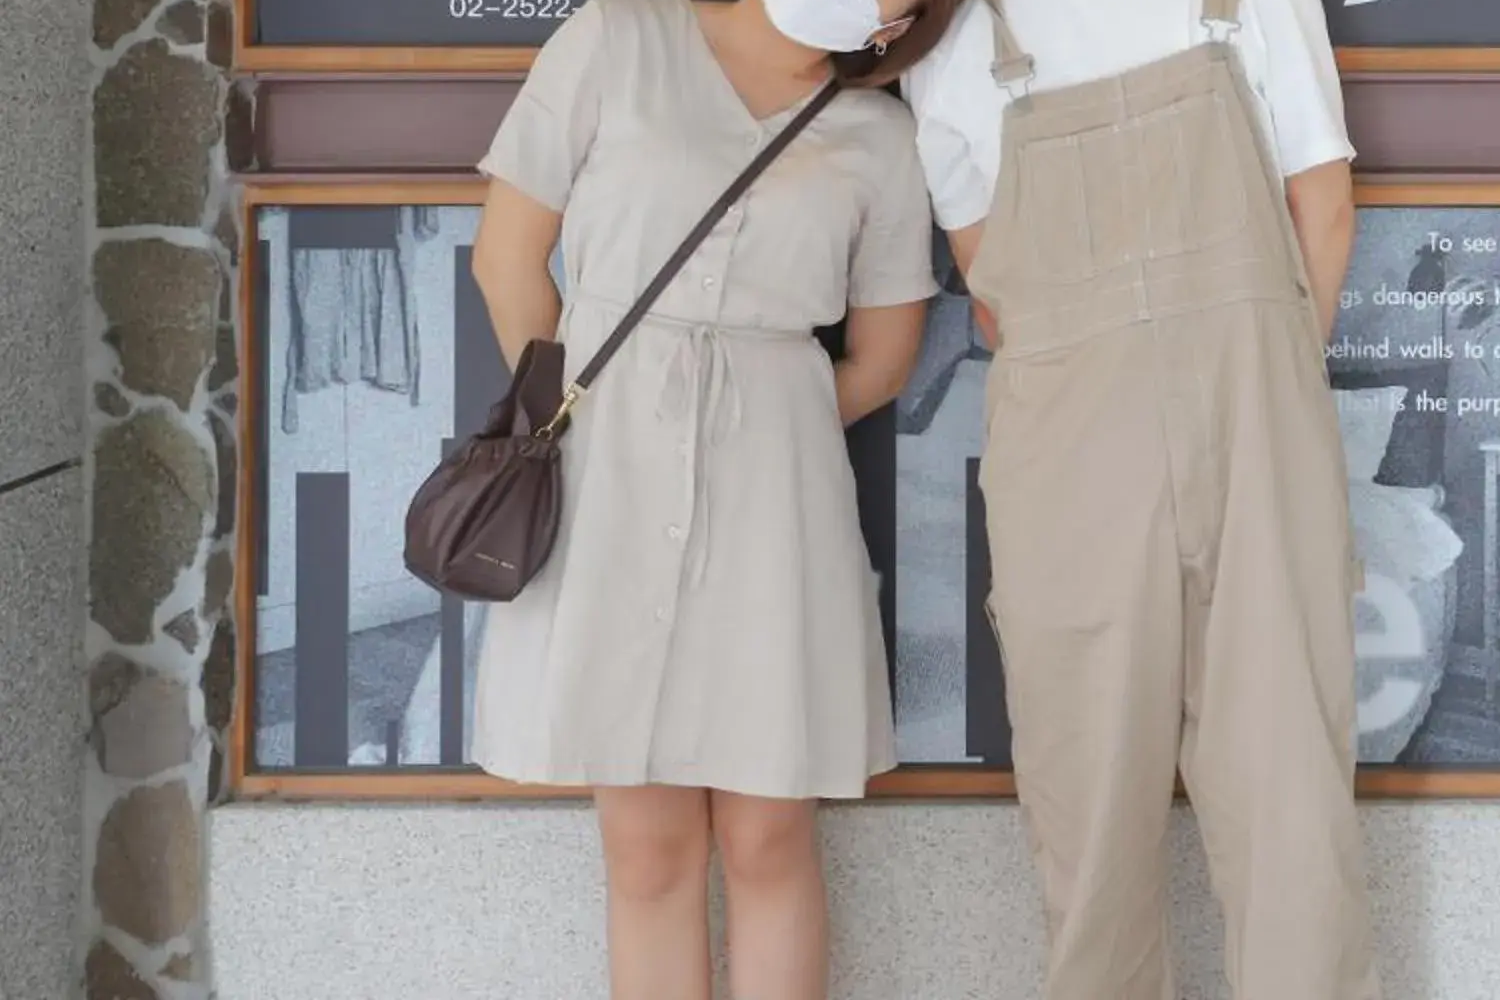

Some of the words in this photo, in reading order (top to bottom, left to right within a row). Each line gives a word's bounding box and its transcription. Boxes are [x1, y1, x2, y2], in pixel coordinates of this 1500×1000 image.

[1428, 232, 1453, 252] To
[1463, 237, 1497, 252] see
[1373, 282, 1485, 311] dangerous
[1400, 335, 1454, 359] walls
[1464, 340, 1484, 359] to
[1416, 389, 1448, 412] the
